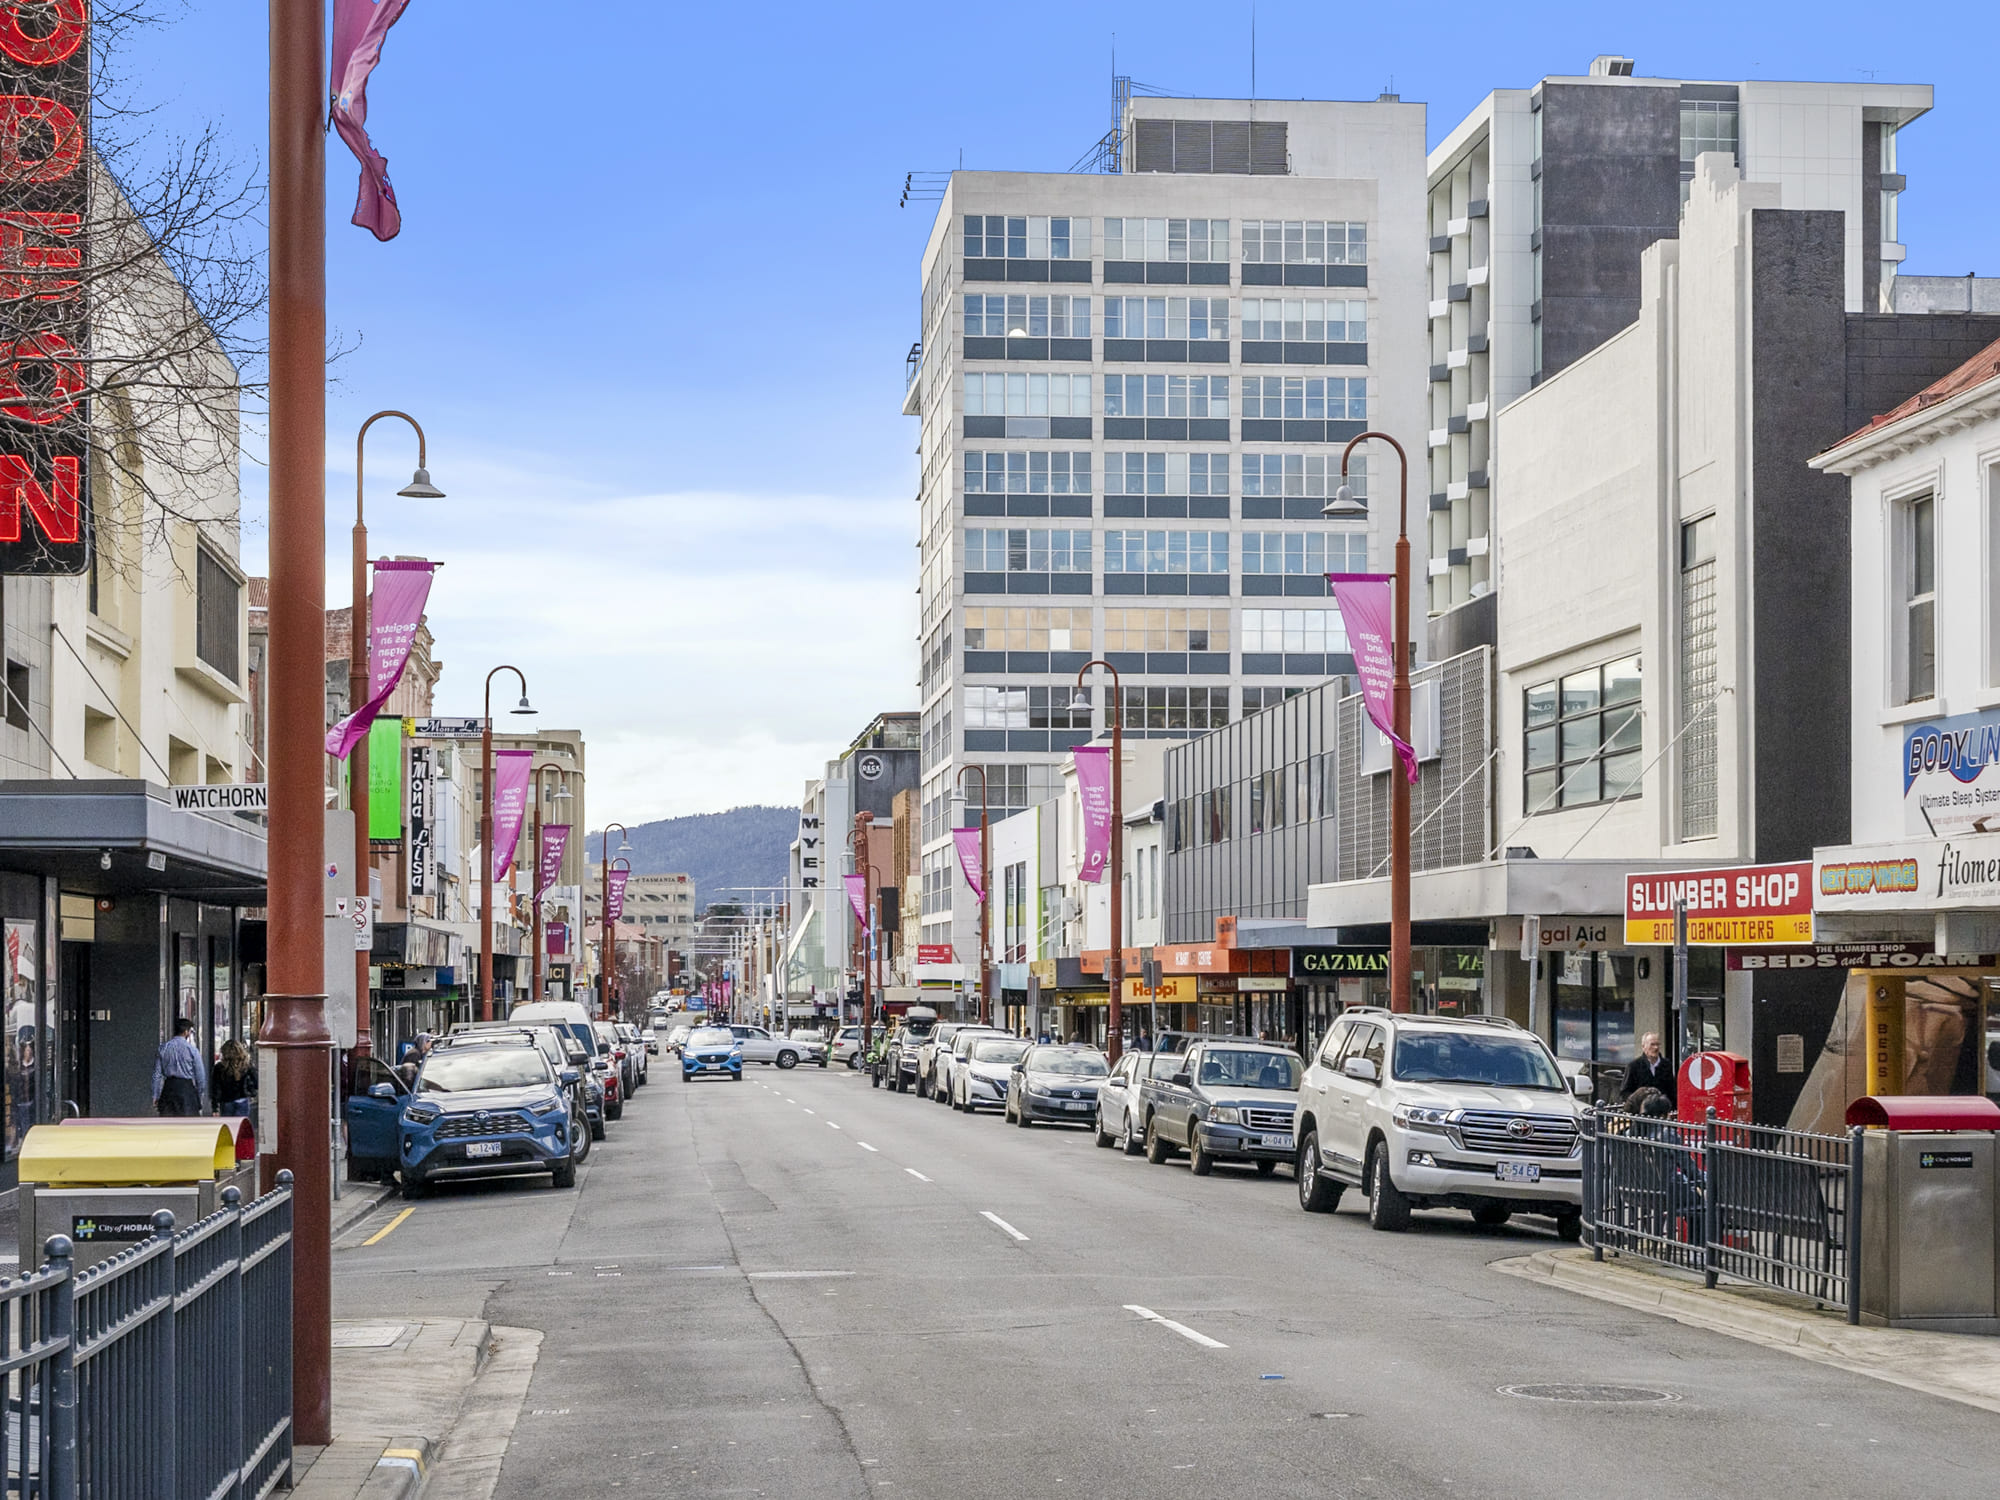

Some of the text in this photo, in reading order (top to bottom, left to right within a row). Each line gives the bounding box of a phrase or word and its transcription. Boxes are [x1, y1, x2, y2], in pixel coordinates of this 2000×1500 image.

[420, 720, 455, 732] Mona
[412, 761, 427, 817] Mona
[175, 787, 267, 809] WATCHORN
[1920, 794, 1950, 808] Ultimate
[1952, 791, 1973, 808] Sleep
[412, 829, 428, 887] Lisa
[802, 818, 819, 888] MYER
[1821, 864, 1916, 891] NEXT STOP VINTAGE
[1632, 873, 1799, 912] SLUMBER SHOP
[1575, 926, 1606, 941] Aid
[1793, 922, 1810, 933] 162
[1834, 945, 1877, 953] SLUMBER
[1879, 944, 1906, 952] SHOP
[1742, 952, 1980, 969] BEDS and FOAM
[1133, 982, 1177, 998] Happi
[1512, 1165, 1524, 1176] 54
[1526, 1166, 1538, 1177] EX
[99, 1224, 113, 1232] City
[114, 1224, 123, 1233] of
